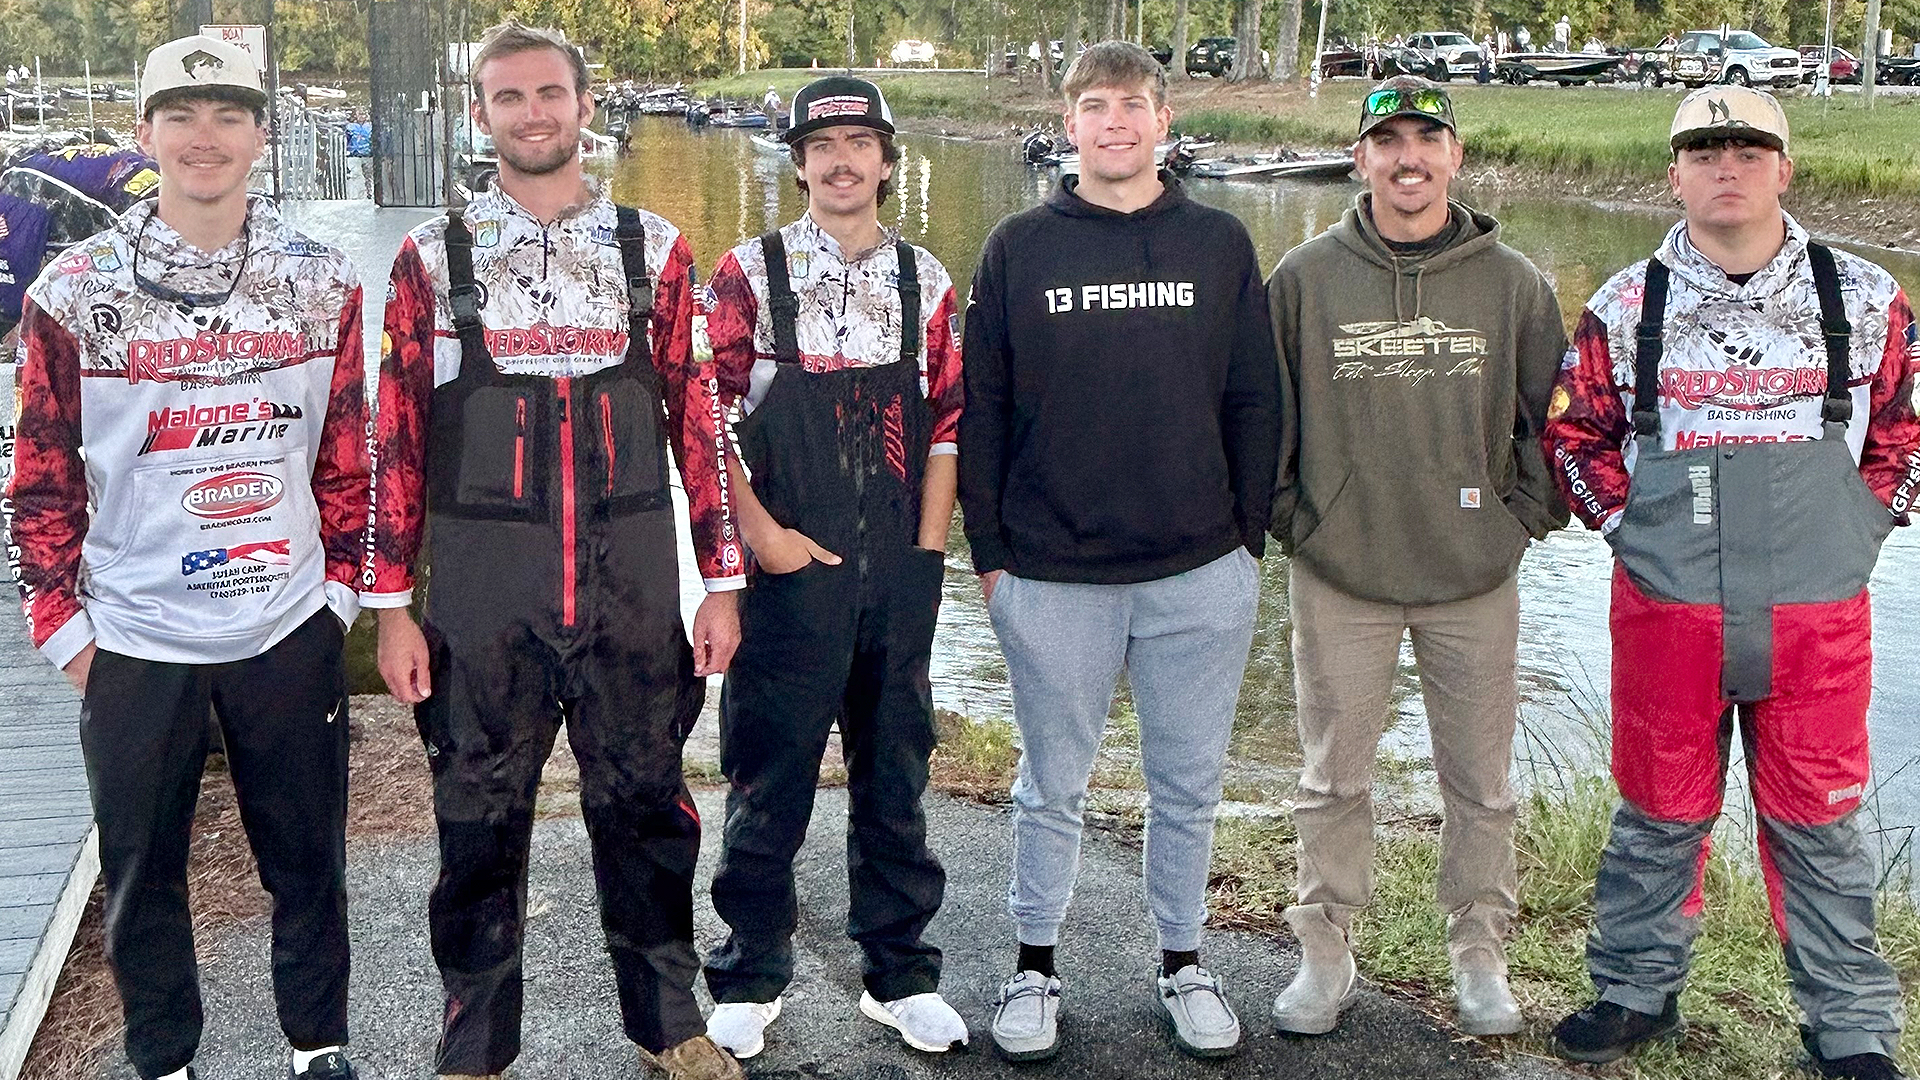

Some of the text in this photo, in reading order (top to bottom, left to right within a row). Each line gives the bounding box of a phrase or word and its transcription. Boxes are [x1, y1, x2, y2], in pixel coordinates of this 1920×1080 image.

[1045, 282, 1195, 313] 13 FISHING
[1333, 336, 1488, 357] SKEETER
[148, 396, 274, 432] Malone's
[1707, 409, 1797, 421] BASS FISHING
[196, 421, 289, 448] Marine
[189, 480, 277, 505] BRADEN
